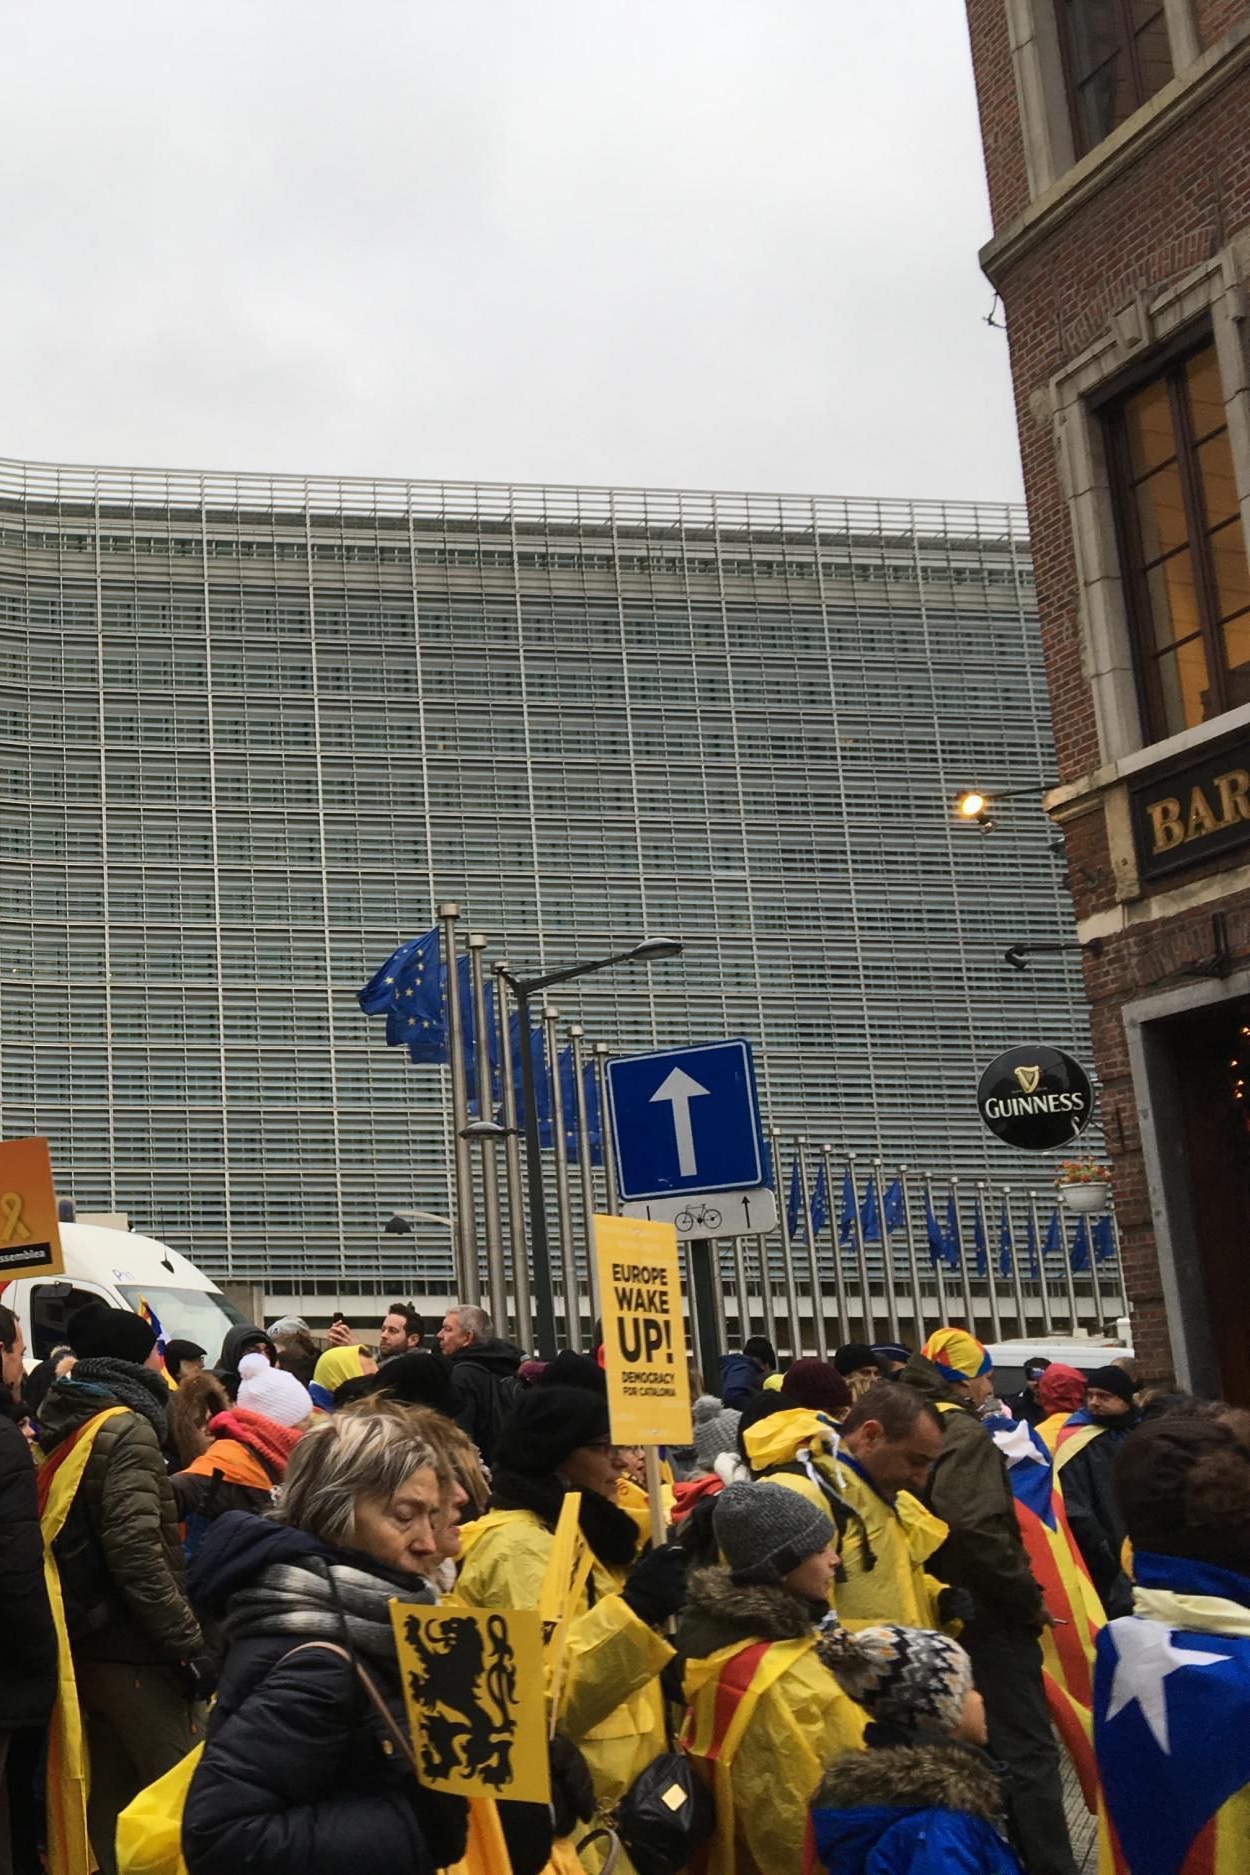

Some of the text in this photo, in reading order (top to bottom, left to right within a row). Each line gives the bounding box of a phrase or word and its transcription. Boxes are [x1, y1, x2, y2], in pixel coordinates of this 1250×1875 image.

[1146, 768, 1250, 854] BAR
[985, 1092, 1085, 1119] GUINNESS
[612, 1263, 668, 1286] EUROPE
[614, 1287, 670, 1314] WAKE
[617, 1316, 674, 1364] UP!
[622, 1371, 675, 1385] DEMOCRACY
[623, 1386, 676, 1397] FOR CATALONIA
